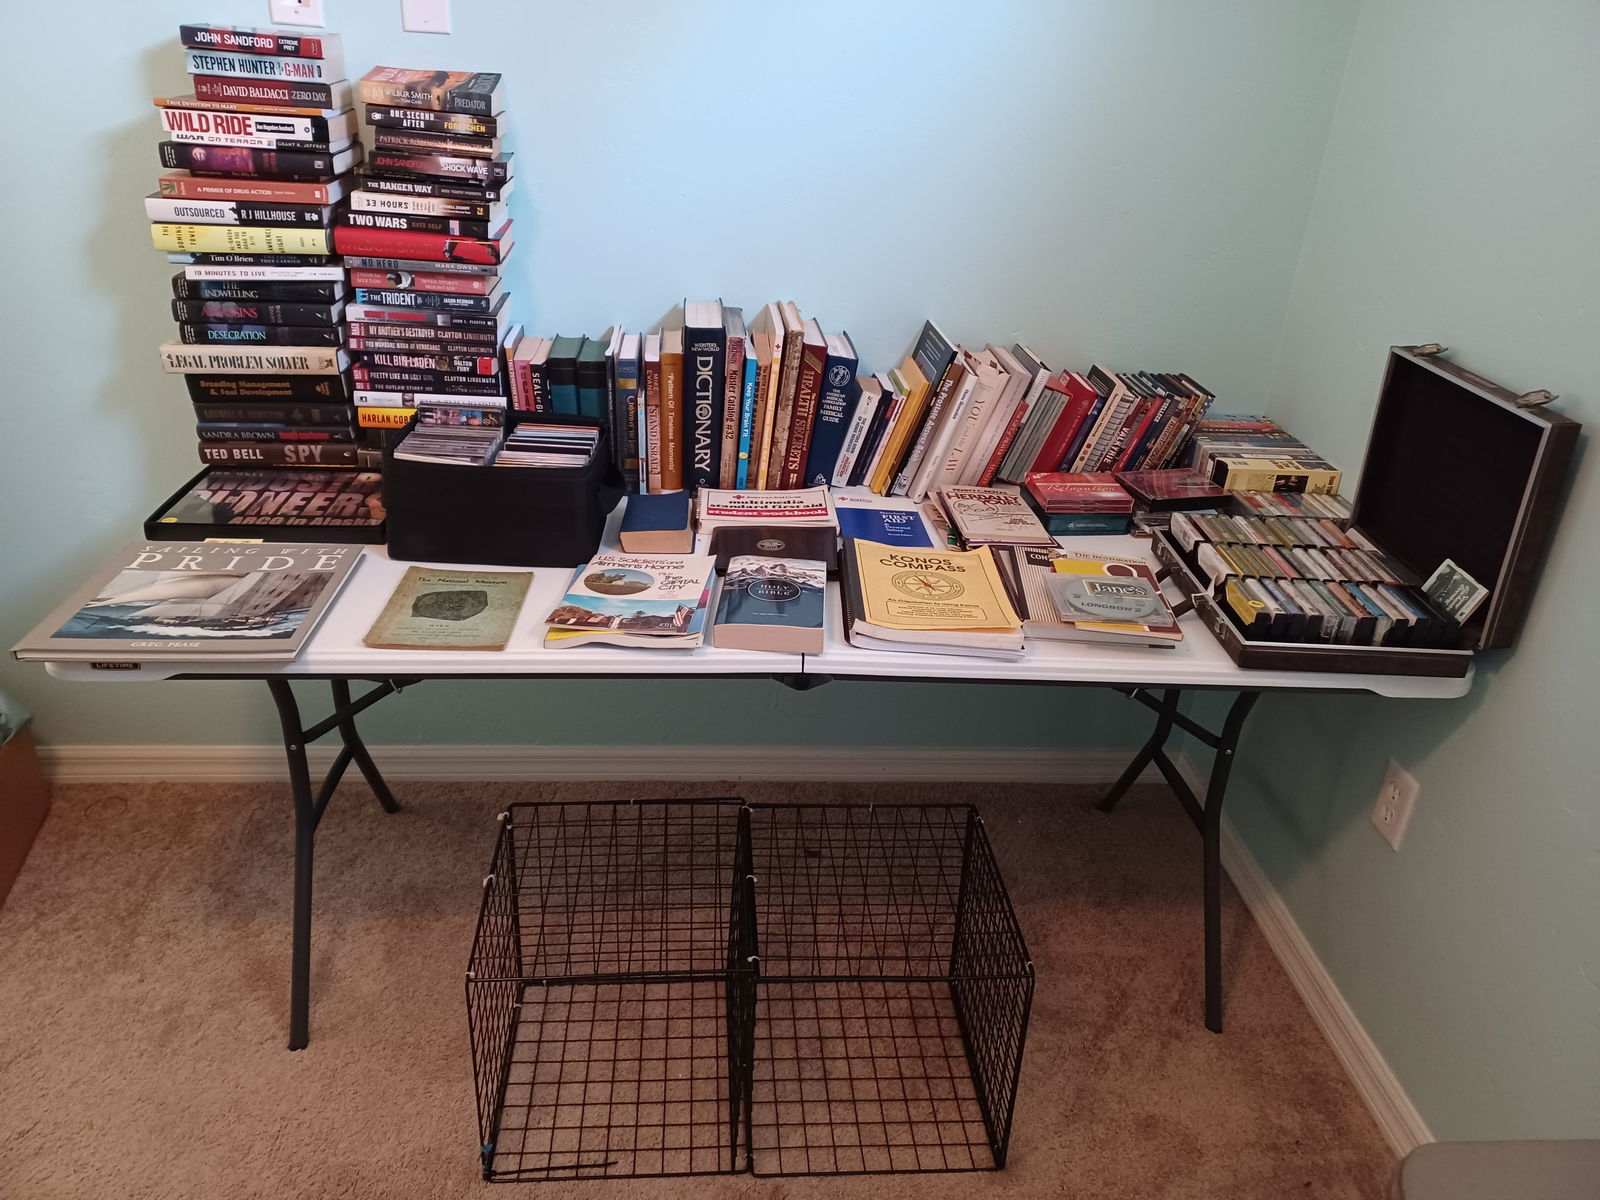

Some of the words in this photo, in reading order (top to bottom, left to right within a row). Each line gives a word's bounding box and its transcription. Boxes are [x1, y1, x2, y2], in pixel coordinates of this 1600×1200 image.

[195, 31, 221, 44] JOHN
[224, 34, 273, 49] SANDFORD
[192, 55, 236, 72] STEPHEN
[238, 58, 275, 75] HUNTER
[284, 63, 314, 78] G-MAN
[223, 86, 248, 97] DAVID
[249, 88, 289, 100] BALDACCI
[292, 91, 311, 100] ZERO
[313, 93, 326, 101] DAY
[385, 89, 410, 98] WILBUR
[411, 92, 432, 100] SMITH
[454, 98, 486, 109] PREDATOR
[390, 110, 404, 118] ONE
[407, 111, 434, 120] SECOND
[165, 111, 211, 132] WILD
[213, 115, 253, 135] RIDE
[403, 119, 424, 128] AFTER
[225, 137, 263, 145] TERROR
[441, 163, 466, 173] SHOCK
[467, 166, 488, 175] WAVE
[380, 182, 413, 192] RANGER
[414, 185, 432, 193] WAY
[380, 201, 408, 209] HOURS
[174, 207, 225, 218] OUTSOURCED
[255, 212, 296, 221] HILLHOUSE
[348, 214, 373, 226] TWO
[375, 217, 408, 229] WARS
[225, 254, 253, 262] O'Brien
[362, 258, 373, 266] NO
[377, 260, 398, 269] HERO
[205, 289, 258, 298] INDWELLING
[381, 292, 416, 306] TRIDENT
[208, 330, 266, 340] DESECRATION
[369, 327, 377, 335] MY
[378, 327, 404, 337] BROTHER'S
[406, 328, 435, 338] DESTROYER
[438, 331, 462, 340] CLAYTON
[463, 332, 495, 341] LINDEMUTH
[170, 355, 206, 368] LEGAL
[209, 356, 263, 369] PROBLEM
[266, 357, 309, 370] SOLVER
[374, 353, 392, 365] KILL
[406, 356, 436, 369] LADEN
[370, 371, 388, 379] PRETTY
[390, 372, 401, 380] LIKE
[728, 369, 736, 393] Master
[530, 372, 542, 395] SEAL
[942, 378, 954, 392] The
[797, 369, 814, 417] HEALTH
[960, 388, 969, 401] Home
[535, 403, 543, 413] GI
[668, 400, 674, 408] Of
[725, 395, 735, 422] Catalog
[929, 390, 948, 421] Prostate
[951, 400, 964, 420] Remedies
[362, 414, 390, 424] HARLAN
[694, 356, 713, 472] DICTIONARY
[648, 408, 657, 437] STAND
[725, 424, 733, 439] #32
[918, 419, 935, 445] Answer
[787, 418, 806, 470] SECRETS
[1103, 426, 1130, 464] VALKYRIE
[205, 449, 228, 459] TED
[234, 449, 263, 459] BELL
[284, 445, 322, 463] SPY
[648, 442, 658, 473] ISRAEL
[910, 444, 924, 463] Book
[945, 447, 963, 472] LAW
[140, 545, 259, 555] SAILING
[280, 547, 350, 555] WITH
[124, 553, 343, 570] PRIDE
[880, 558, 966, 573] COMPASS
[889, 554, 952, 566] KONOS
[1092, 555, 1147, 565] RESTORATION
[1093, 582, 1148, 596] Jane's
[1081, 602, 1133, 612] LONGBOW
